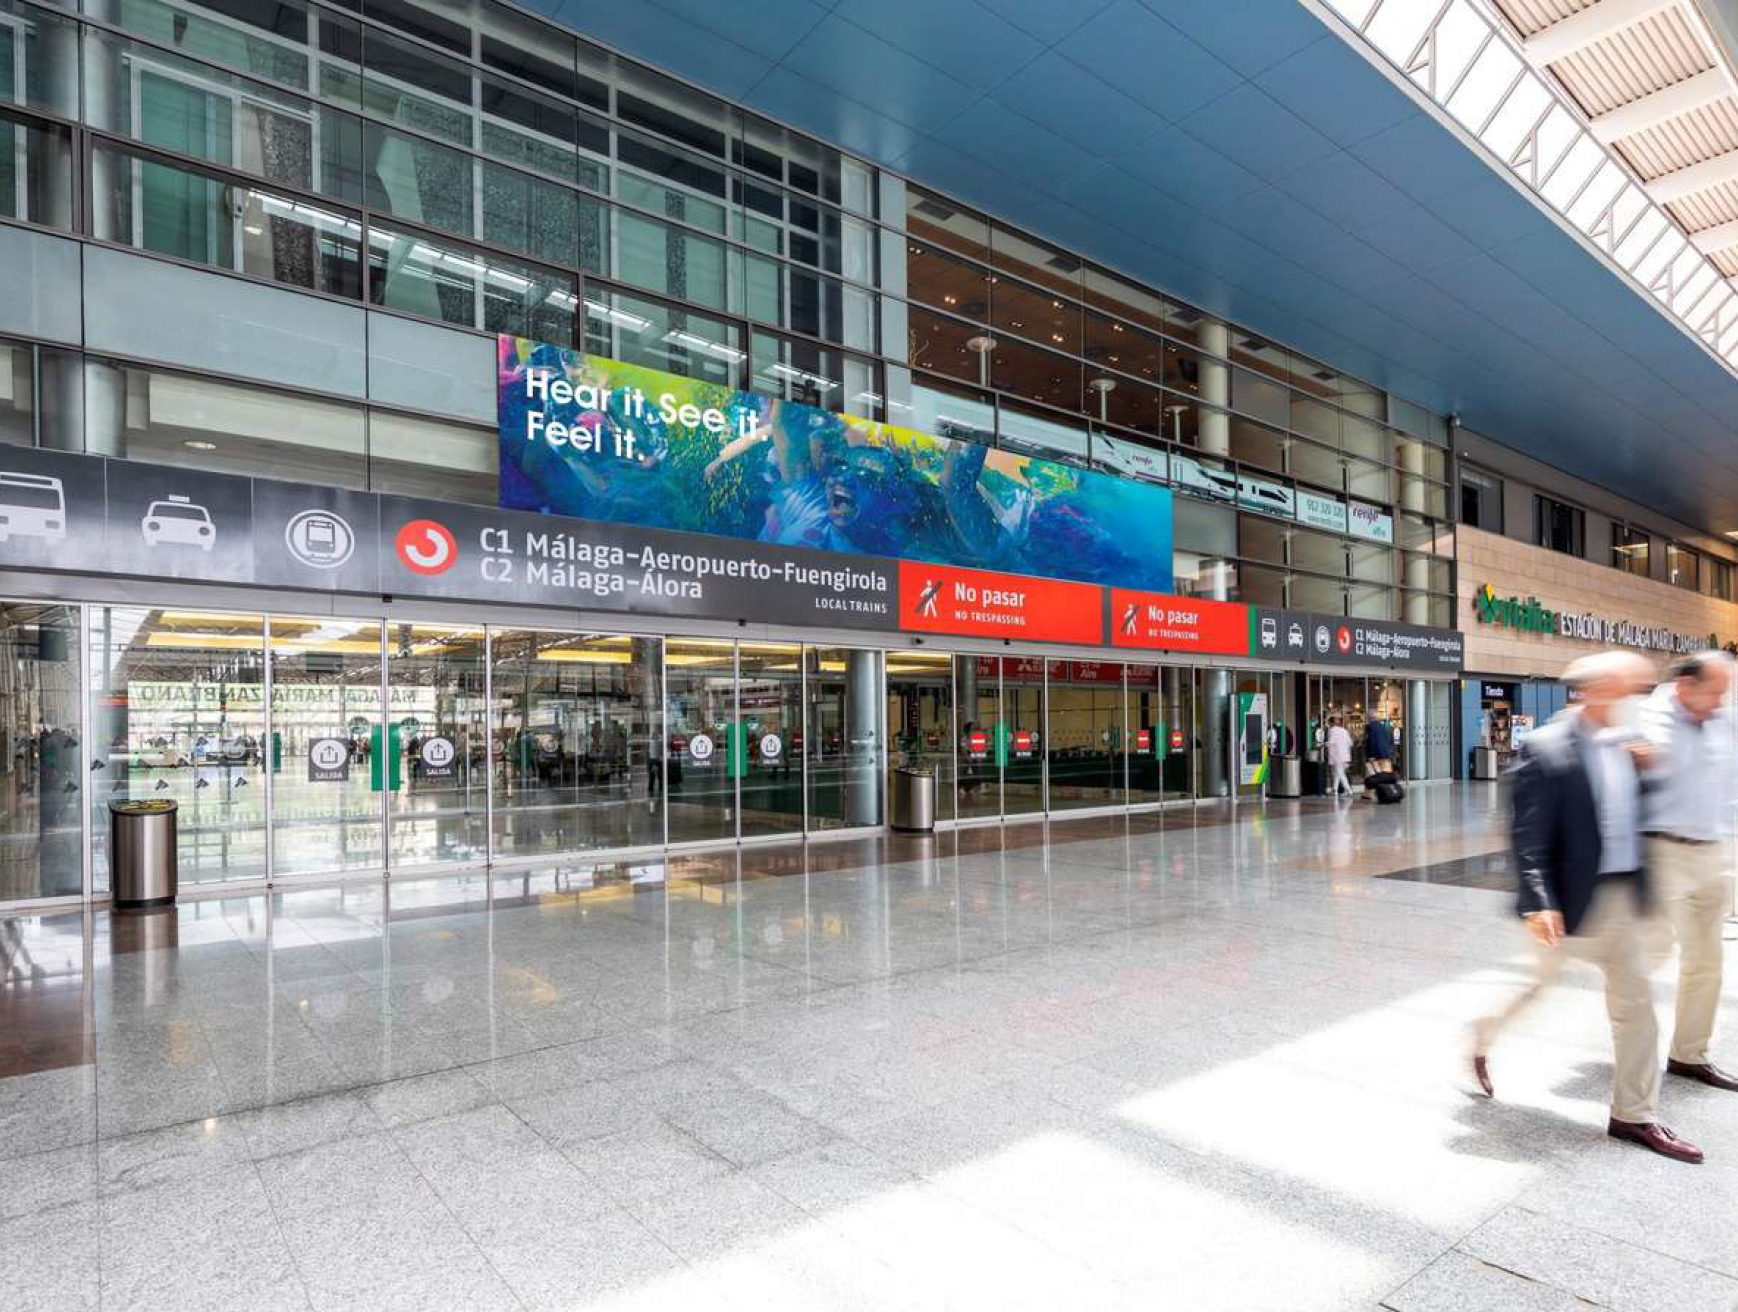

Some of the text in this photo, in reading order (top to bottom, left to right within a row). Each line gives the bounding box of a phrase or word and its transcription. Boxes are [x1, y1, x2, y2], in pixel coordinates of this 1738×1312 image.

[525, 367, 613, 413] Hear
[658, 392, 726, 433] See
[739, 406, 769, 441] it.
[526, 410, 645, 462] Feel it.
[479, 527, 513, 554] C1
[480, 556, 513, 583] C2
[815, 597, 887, 614] LOCAL TRAINS
[955, 581, 1026, 608] No pasar
[955, 611, 1026, 625] NO TRESPASSING
[1148, 606, 1199, 626] No pasar
[1604, 620, 1615, 643] DE
[426, 768, 452, 776] SALIDA
